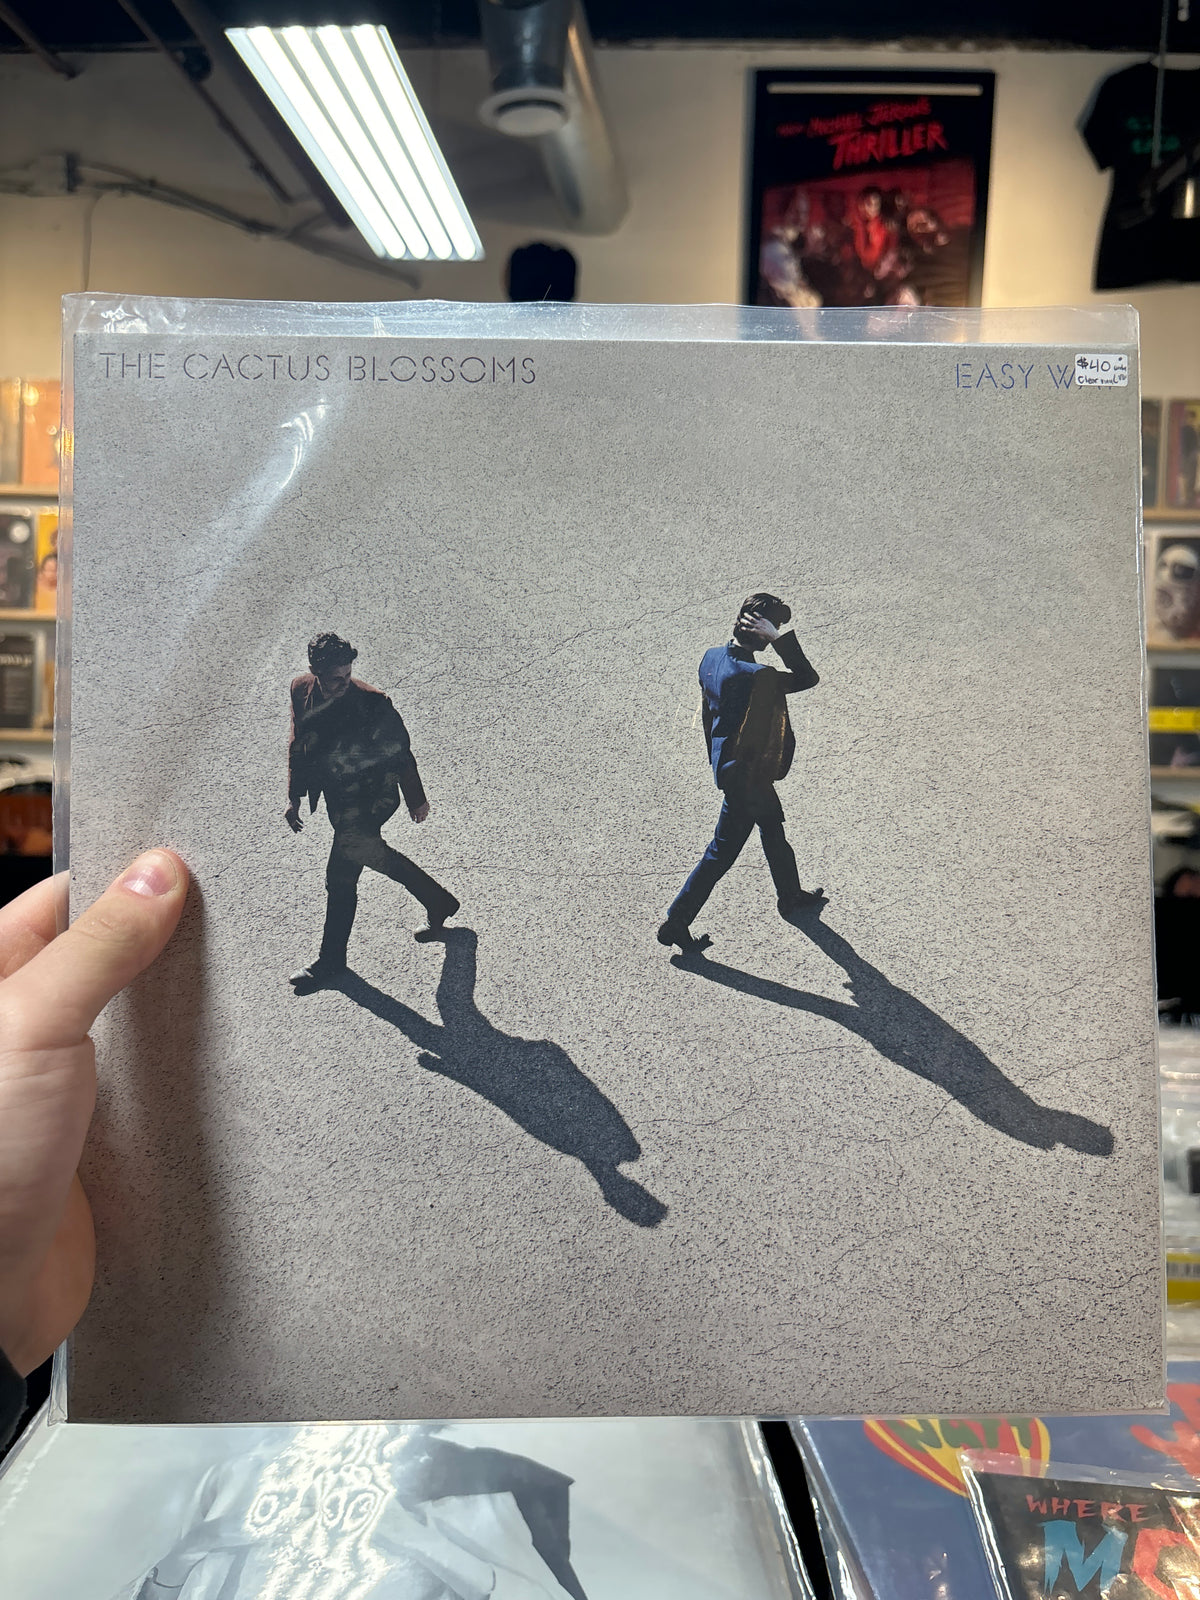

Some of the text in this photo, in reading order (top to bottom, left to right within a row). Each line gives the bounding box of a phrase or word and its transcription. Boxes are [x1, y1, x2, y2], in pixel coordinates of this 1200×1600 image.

[827, 121, 948, 170] THRILLER
[99, 352, 536, 385] THE CACTUS BLOSSOMS
[956, 363, 1034, 390] EASY
[1077, 356, 1111, 372] $40
[1025, 1494, 1153, 1523] WHERE
